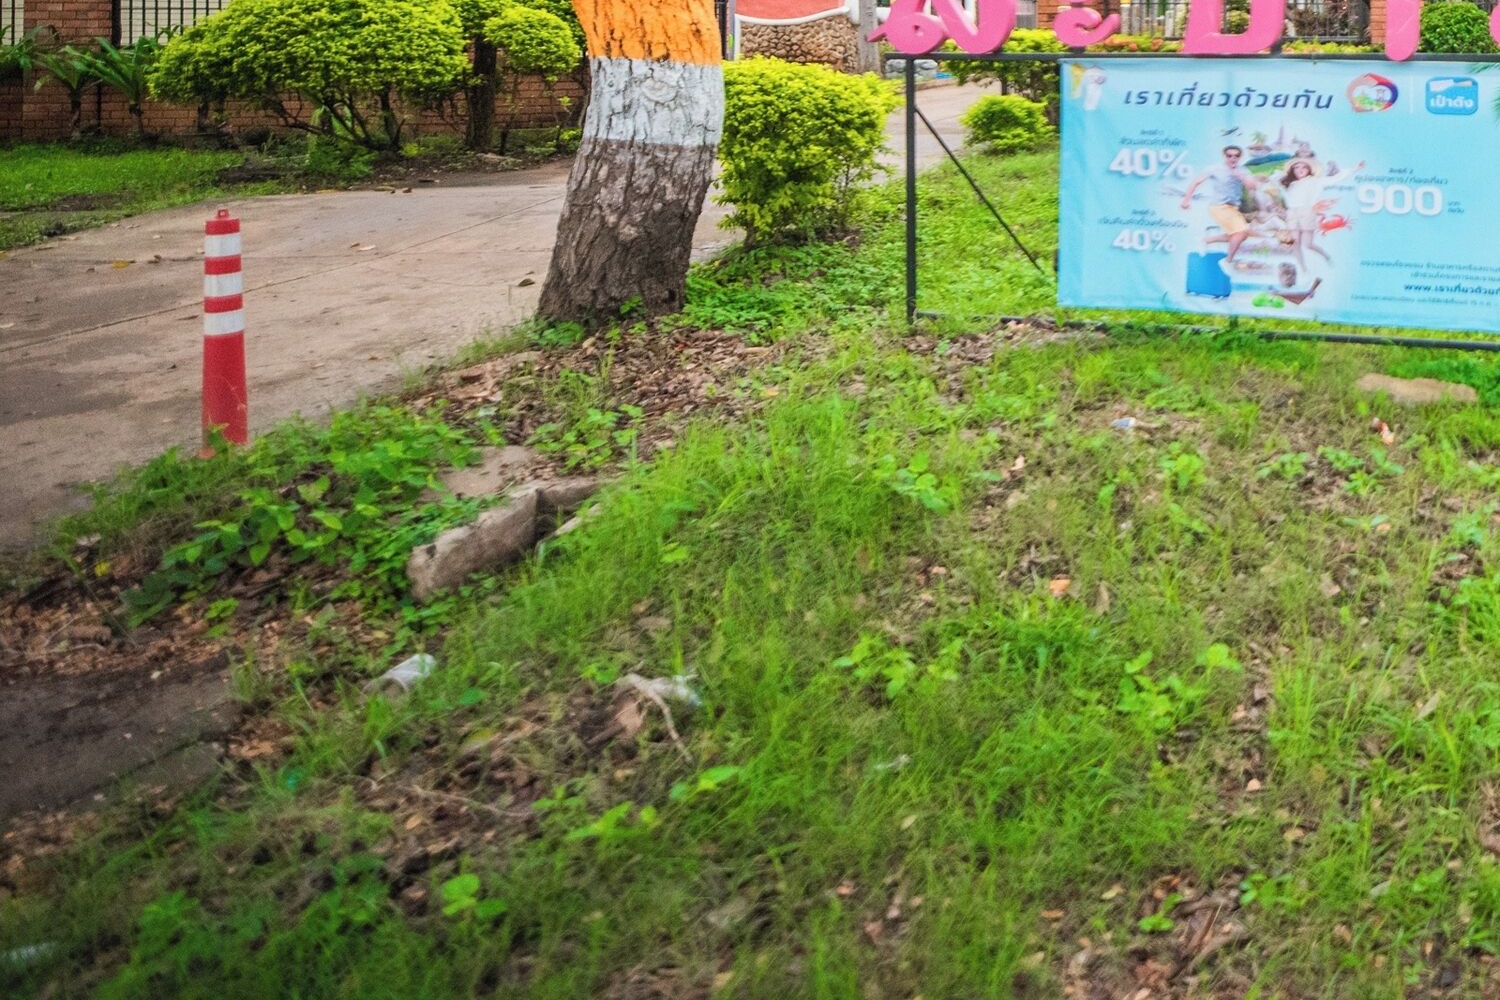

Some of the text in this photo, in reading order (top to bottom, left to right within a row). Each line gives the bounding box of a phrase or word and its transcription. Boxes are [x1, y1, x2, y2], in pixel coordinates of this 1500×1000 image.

[1123, 81, 1334, 110] เราเที่ยวด้วยกัน
[1109, 147, 1194, 178] 40%
[1357, 184, 1443, 215] 900
[1112, 229, 1176, 252] 40%
